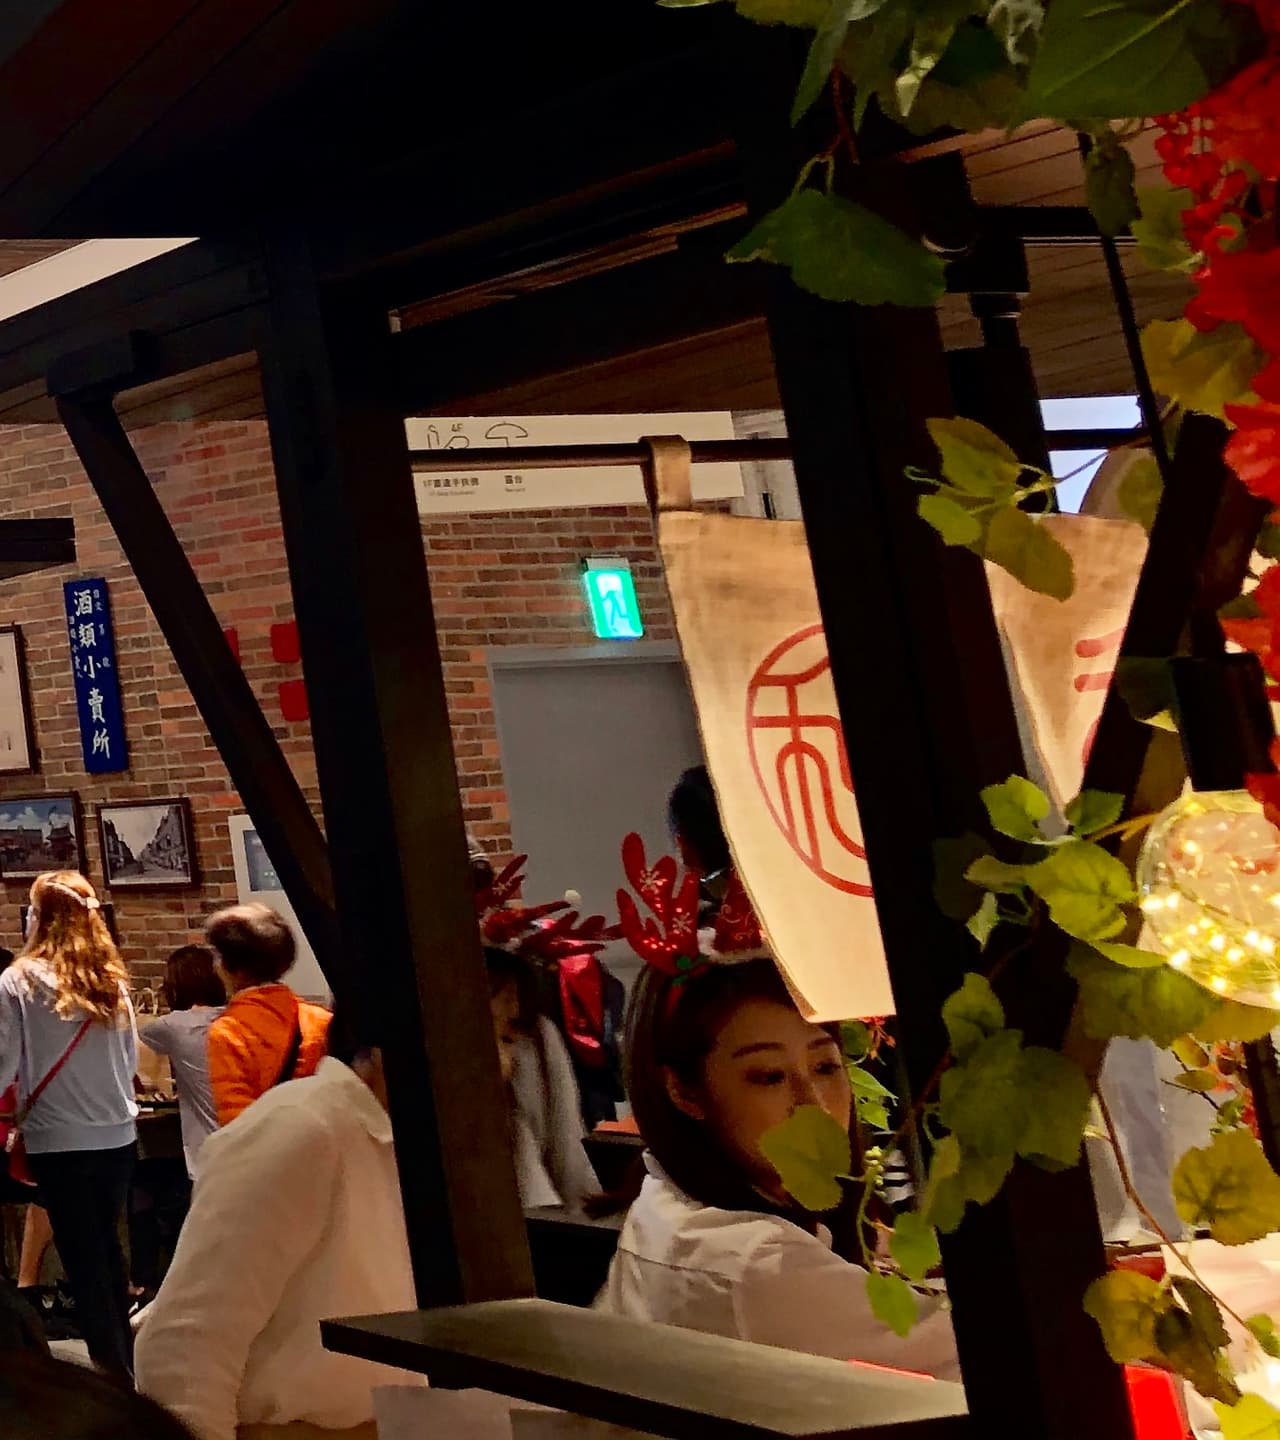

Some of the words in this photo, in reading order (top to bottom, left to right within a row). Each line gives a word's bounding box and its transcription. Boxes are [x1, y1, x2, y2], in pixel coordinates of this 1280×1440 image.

[73, 588, 111, 760] 酒類小賣所
